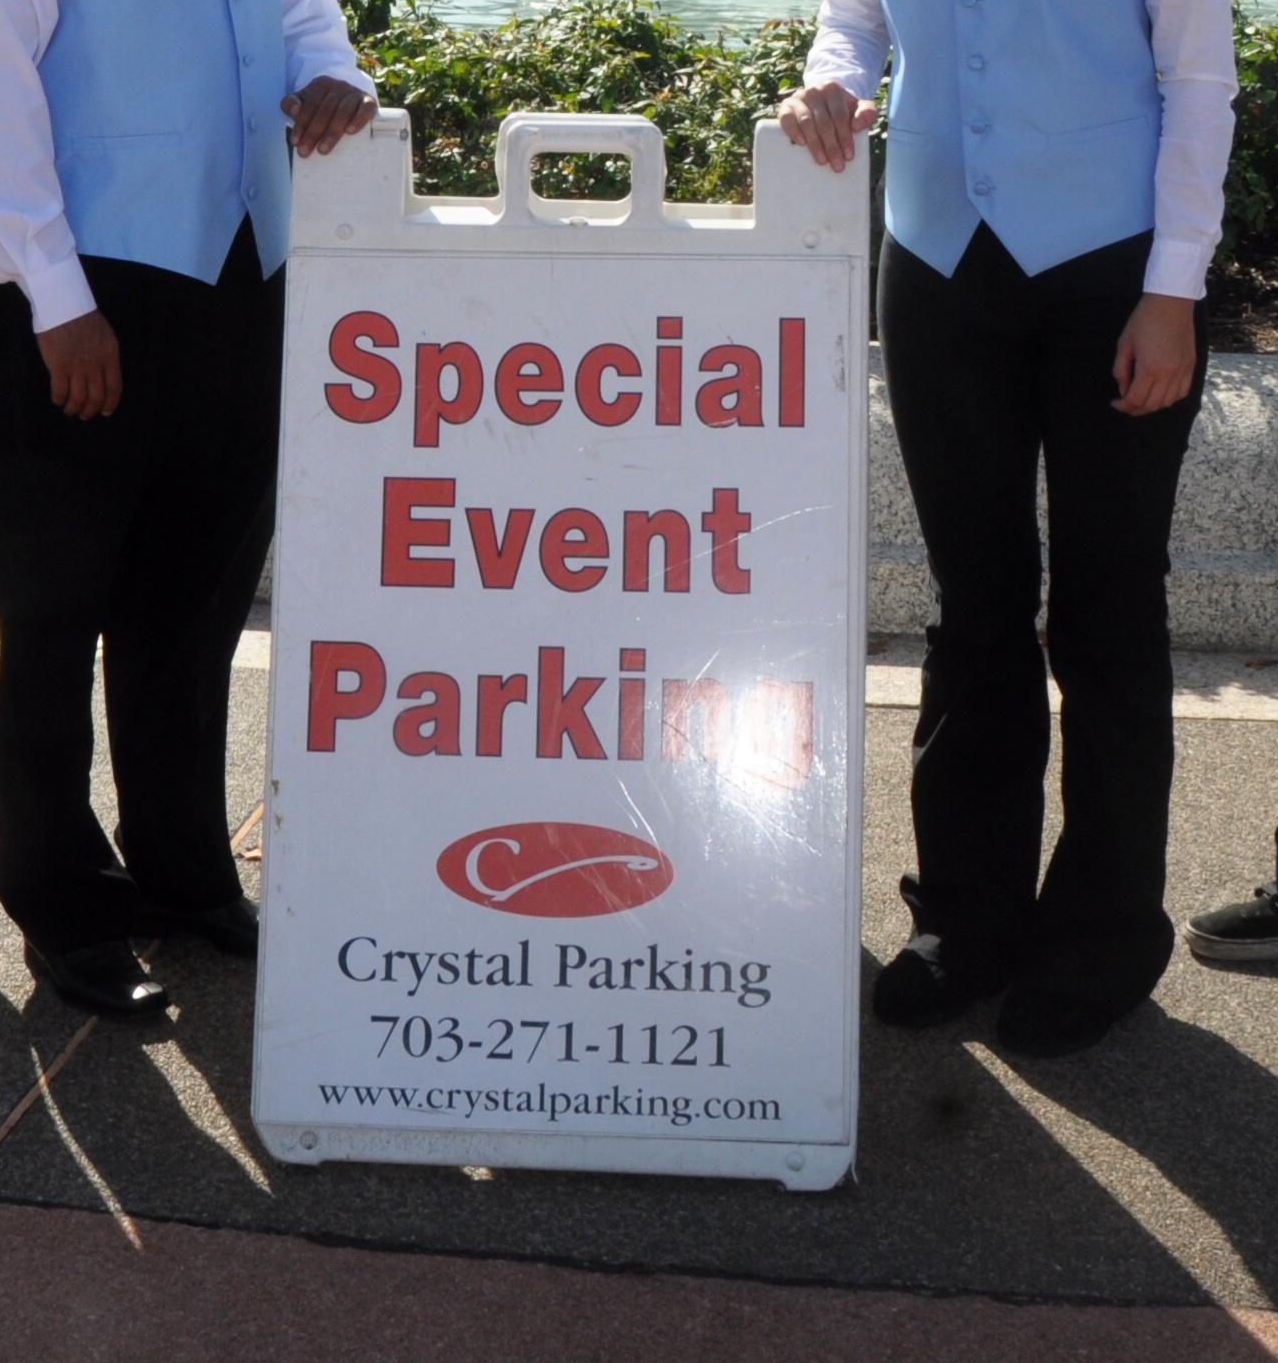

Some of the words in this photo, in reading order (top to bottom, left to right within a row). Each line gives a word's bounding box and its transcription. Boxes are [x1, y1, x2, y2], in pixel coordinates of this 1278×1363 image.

[323, 310, 806, 448] Special
[380, 476, 752, 595] Event
[337, 936, 533, 998] Crystal
[553, 943, 772, 1009] Parking
[370, 1014, 731, 1068] 703-271-1121
[317, 1082, 782, 1126] www.crystalparking.com
